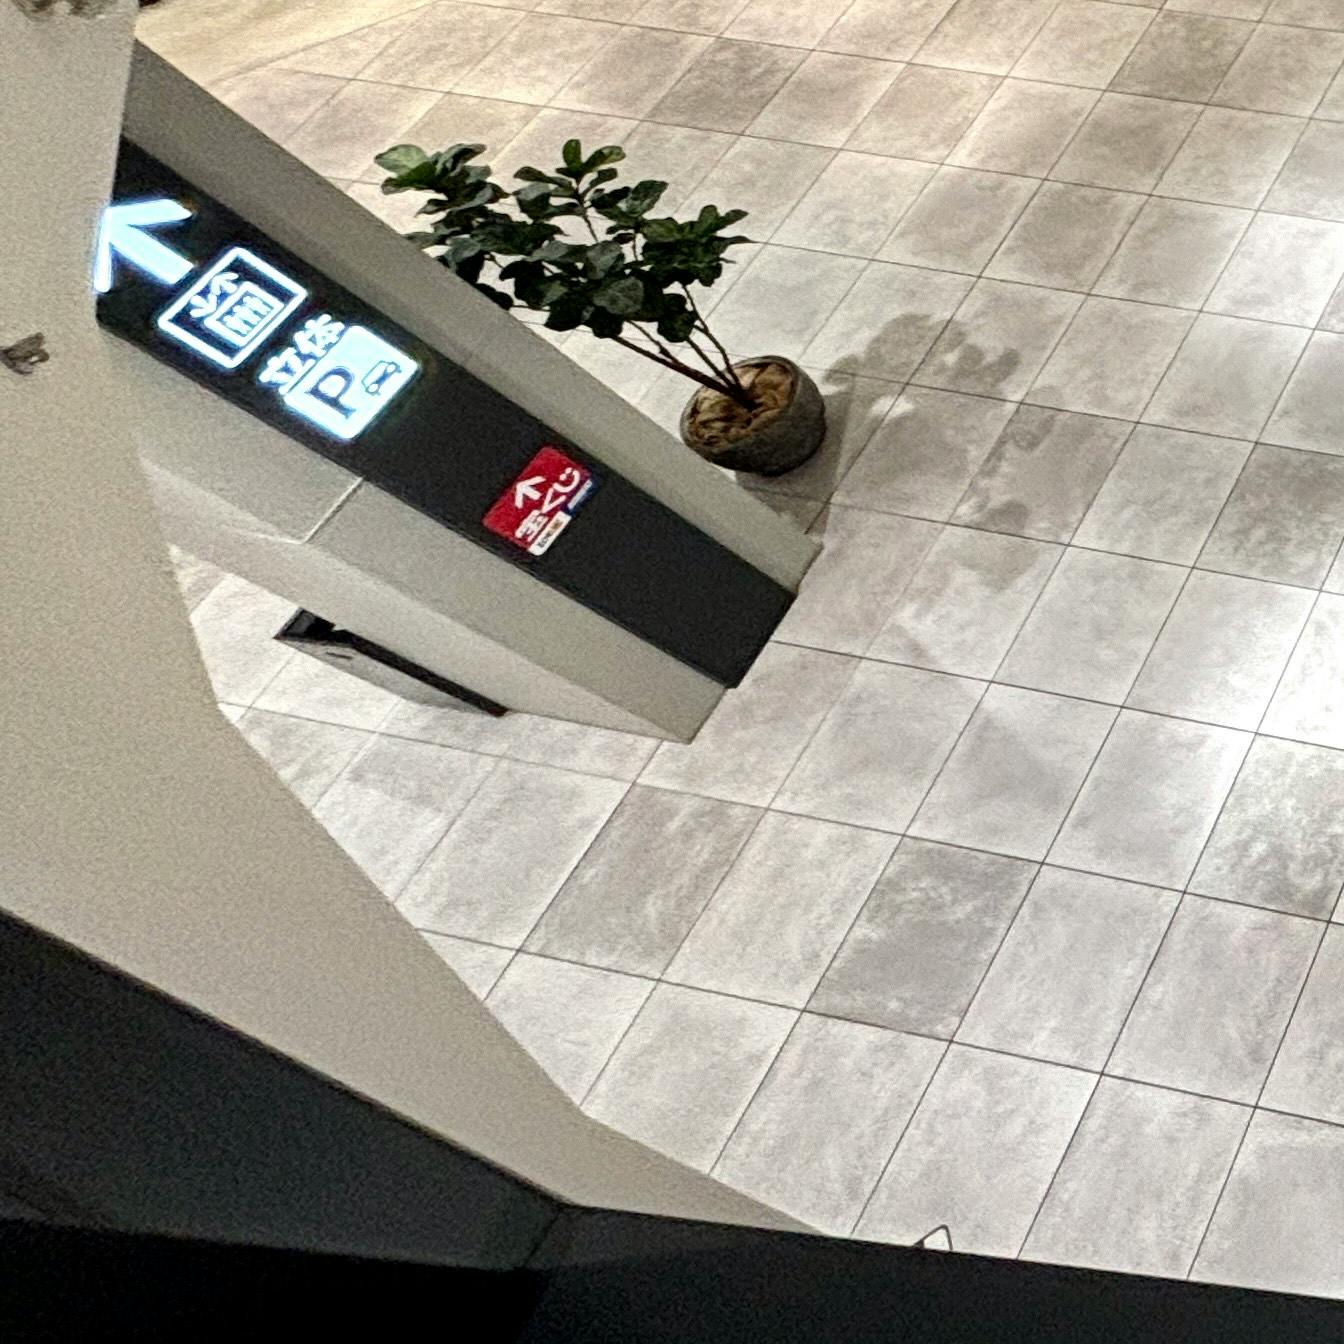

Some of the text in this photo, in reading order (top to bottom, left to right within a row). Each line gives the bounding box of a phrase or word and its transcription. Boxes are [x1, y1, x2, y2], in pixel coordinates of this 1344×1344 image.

[258, 313, 346, 396] 立体
[304, 365, 356, 420] P
[514, 467, 581, 543] 宝くじ
